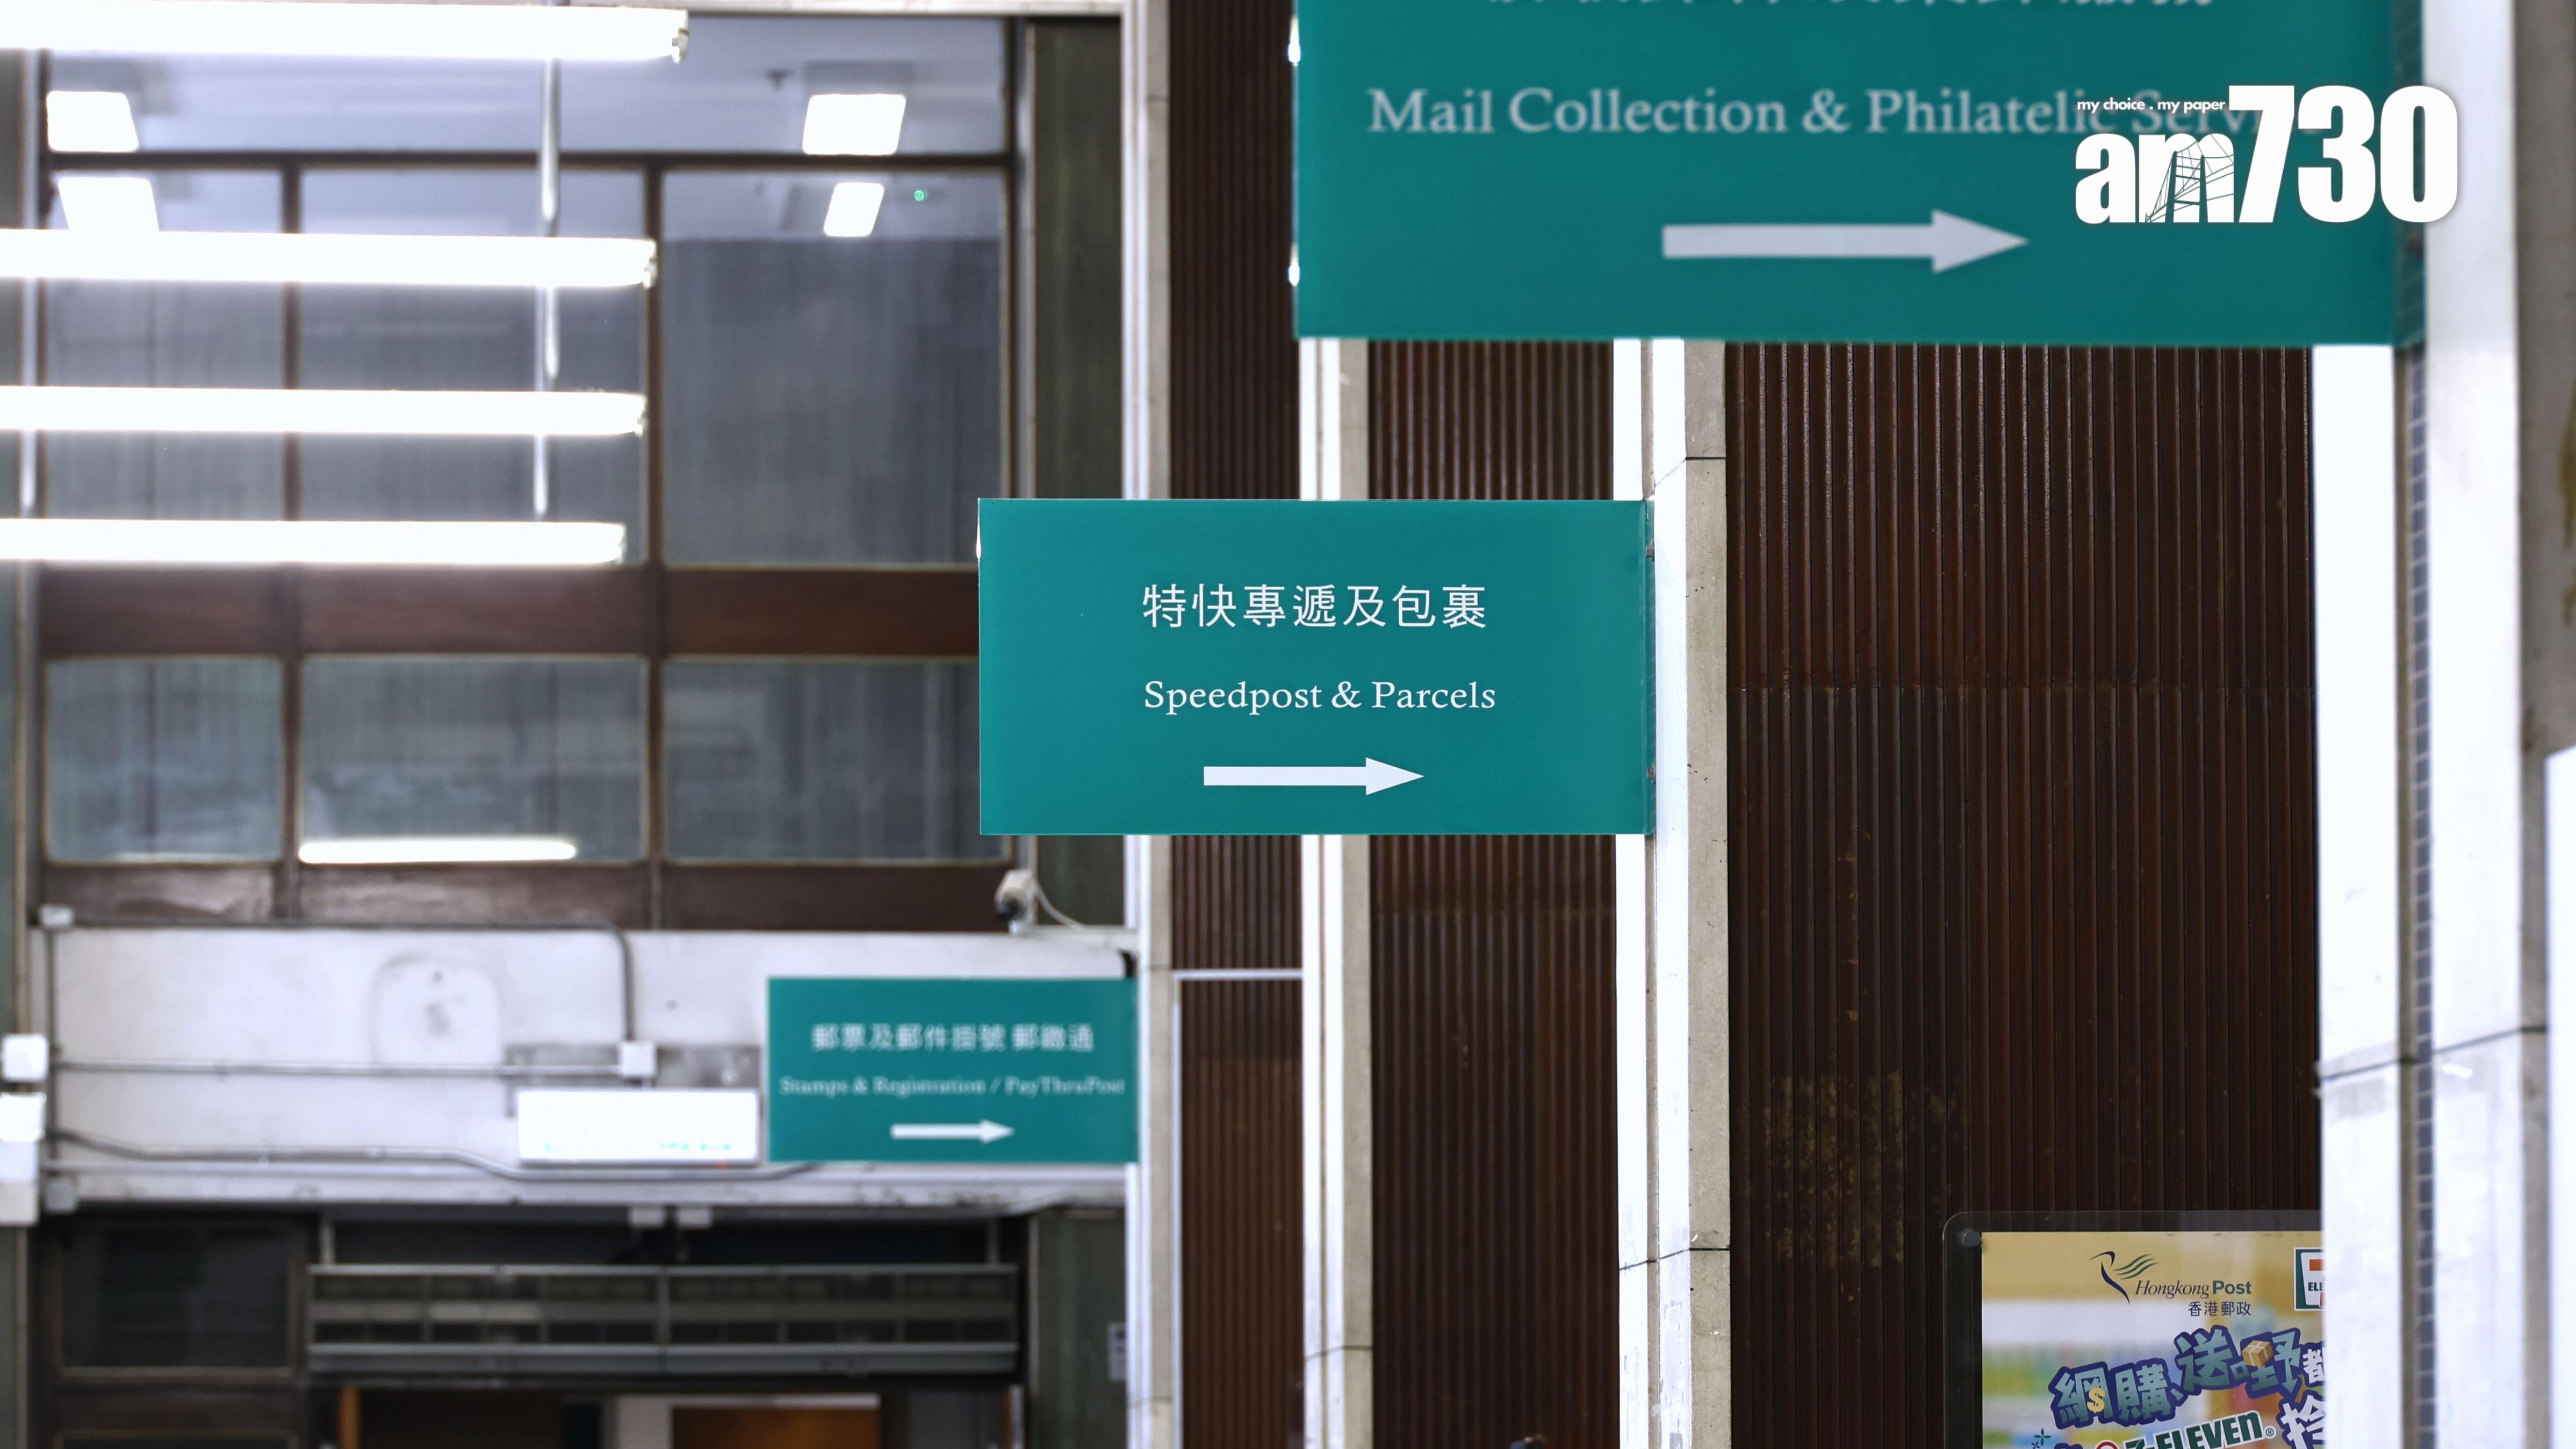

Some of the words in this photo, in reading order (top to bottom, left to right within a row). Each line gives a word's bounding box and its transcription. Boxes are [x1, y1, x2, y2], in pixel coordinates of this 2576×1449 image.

[1368, 88, 1494, 133] Mail
[1509, 88, 1788, 134] Collection
[1802, 89, 1850, 133] &
[1866, 88, 2116, 134] Philatelic
[1142, 583, 1486, 629] 特快專遞及包裹
[1145, 680, 1322, 716] Speedpost
[1331, 681, 1362, 709] &
[1371, 681, 1495, 709] Parcels
[2134, 1280, 2210, 1299] Hongkong
[2212, 1280, 2252, 1294] Post
[2188, 1301, 2251, 1317] 香港郵政
